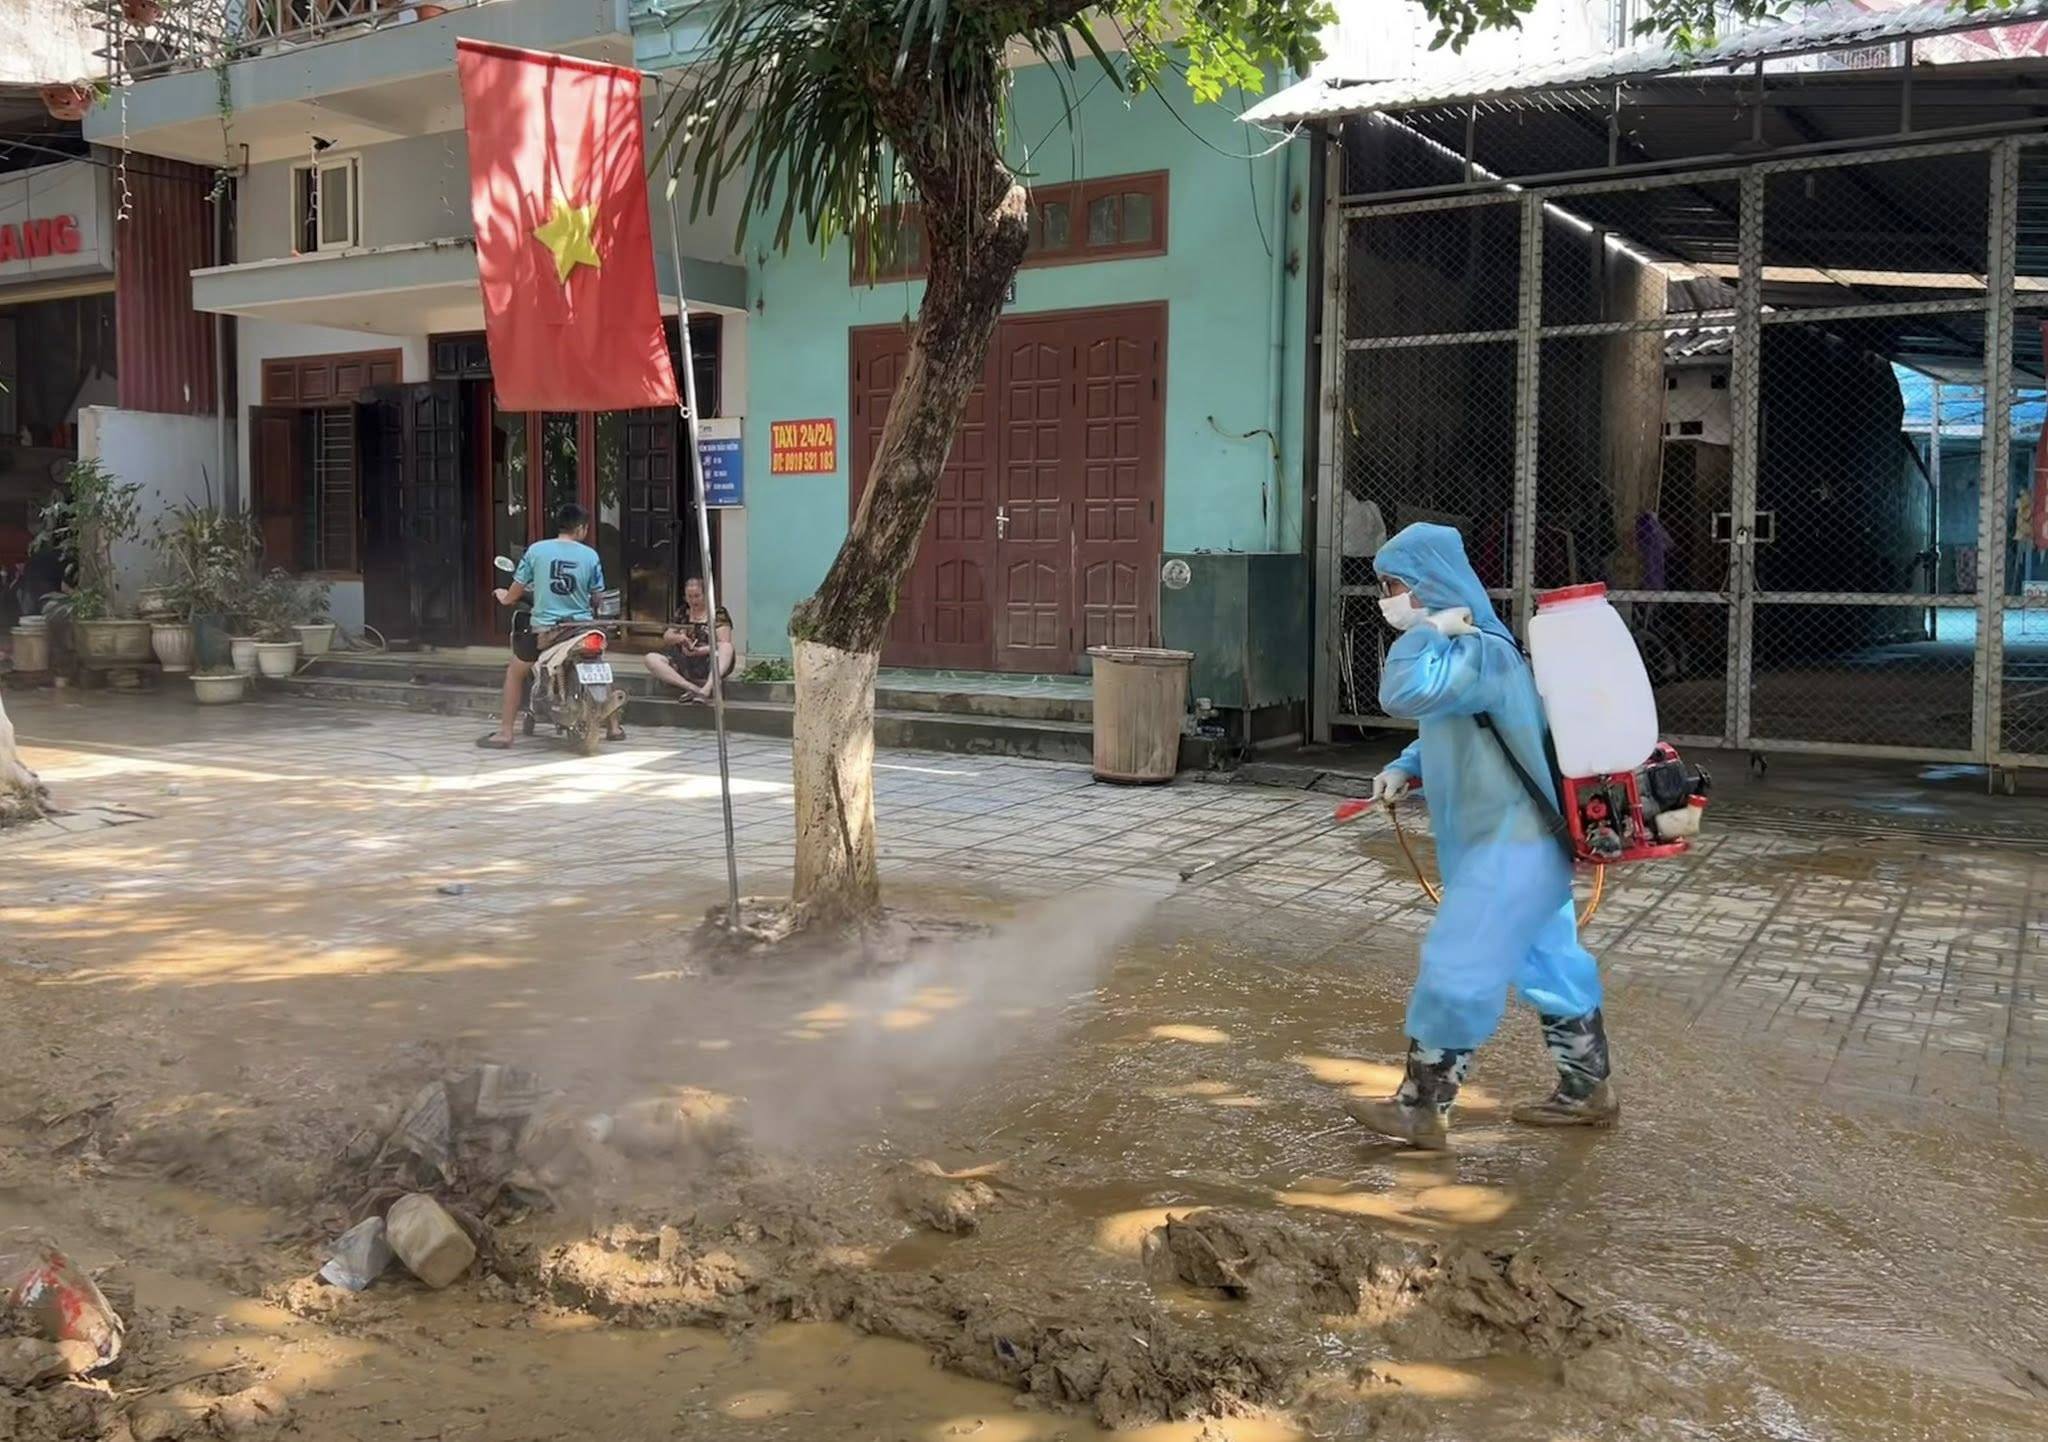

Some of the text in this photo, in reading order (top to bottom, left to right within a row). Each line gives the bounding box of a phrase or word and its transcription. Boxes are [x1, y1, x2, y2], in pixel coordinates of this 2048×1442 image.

[772, 422, 833, 449] TAXI 24/24
[550, 558, 578, 596] 5
